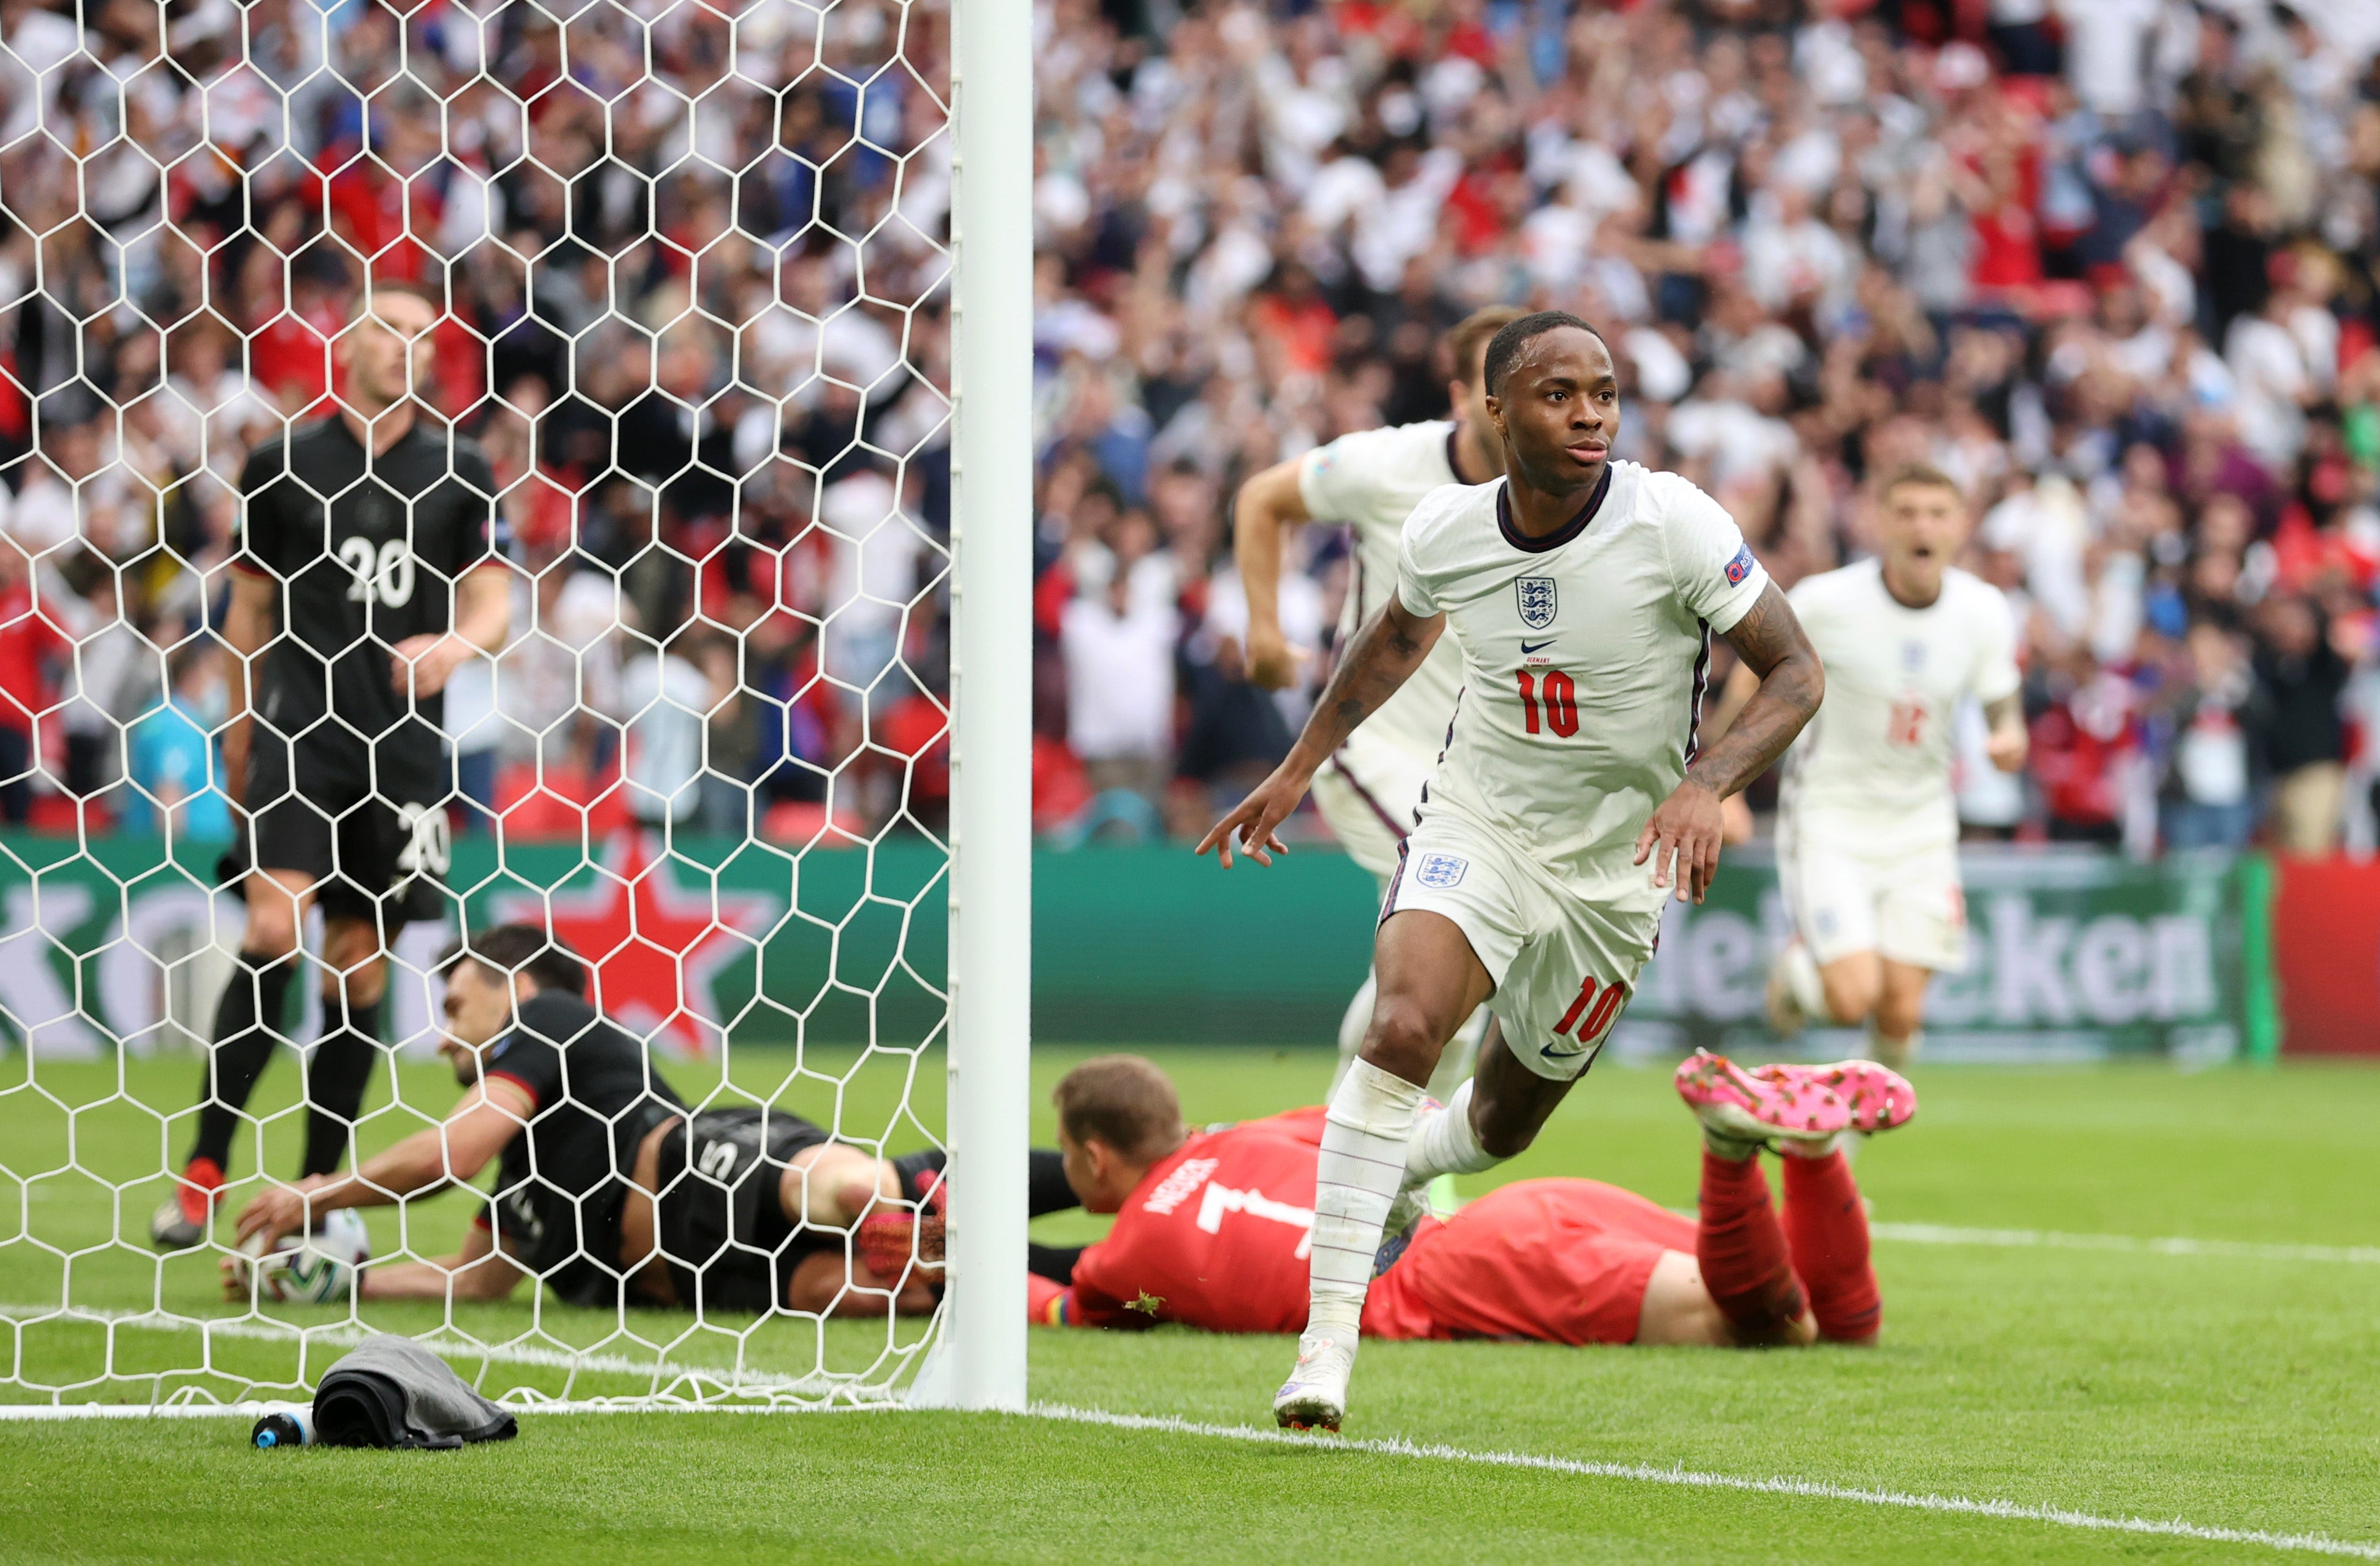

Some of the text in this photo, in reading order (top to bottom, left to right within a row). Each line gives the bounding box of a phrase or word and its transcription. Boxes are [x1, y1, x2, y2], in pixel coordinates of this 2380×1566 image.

[339, 536, 415, 609] 20
[1515, 669, 1579, 738] 10
[398, 801, 450, 875] 20
[1553, 976, 1625, 1042] 10
[698, 1139, 738, 1182] 5
